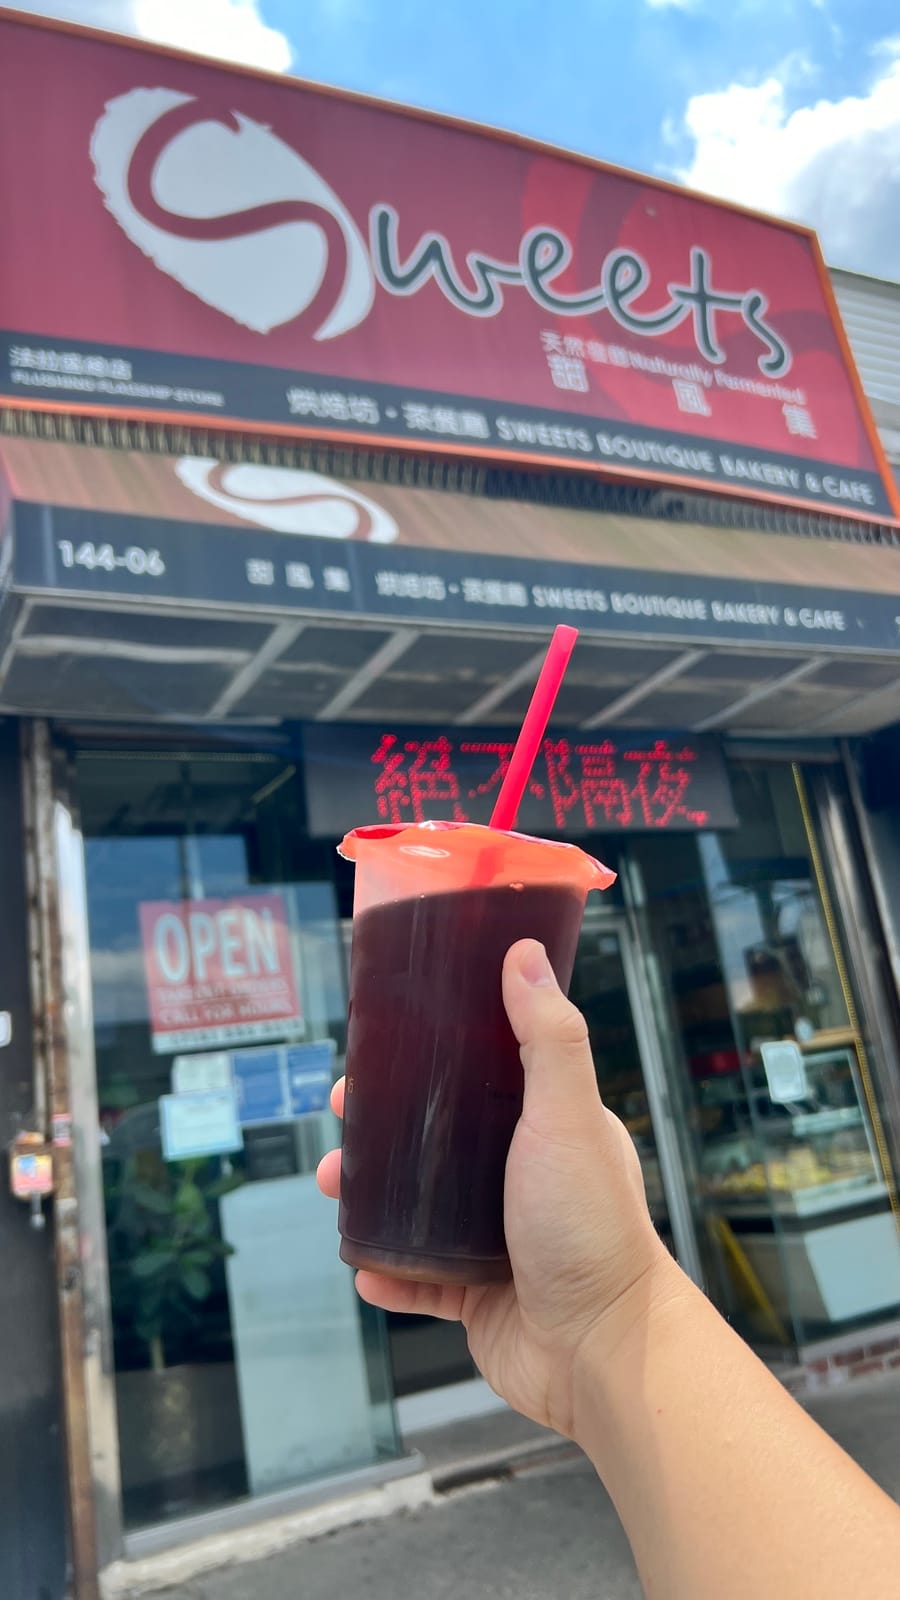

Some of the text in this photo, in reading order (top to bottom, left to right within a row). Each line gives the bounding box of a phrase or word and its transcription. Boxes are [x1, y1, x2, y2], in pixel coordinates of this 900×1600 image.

[89, 86, 793, 379] Sweets
[11, 369, 97, 392] FLUSHING
[629, 352, 713, 387] Naturally
[496, 415, 876, 506] SWEETS BOUTIQUE BAKERY & CAFE
[58, 539, 166, 577] 144-06
[532, 584, 607, 613] SWEETS
[610, 591, 707, 622] BOUTIQUE
[711, 600, 779, 627] BAKERY
[799, 608, 847, 632] CAFE
[154, 908, 280, 984] OPEN
